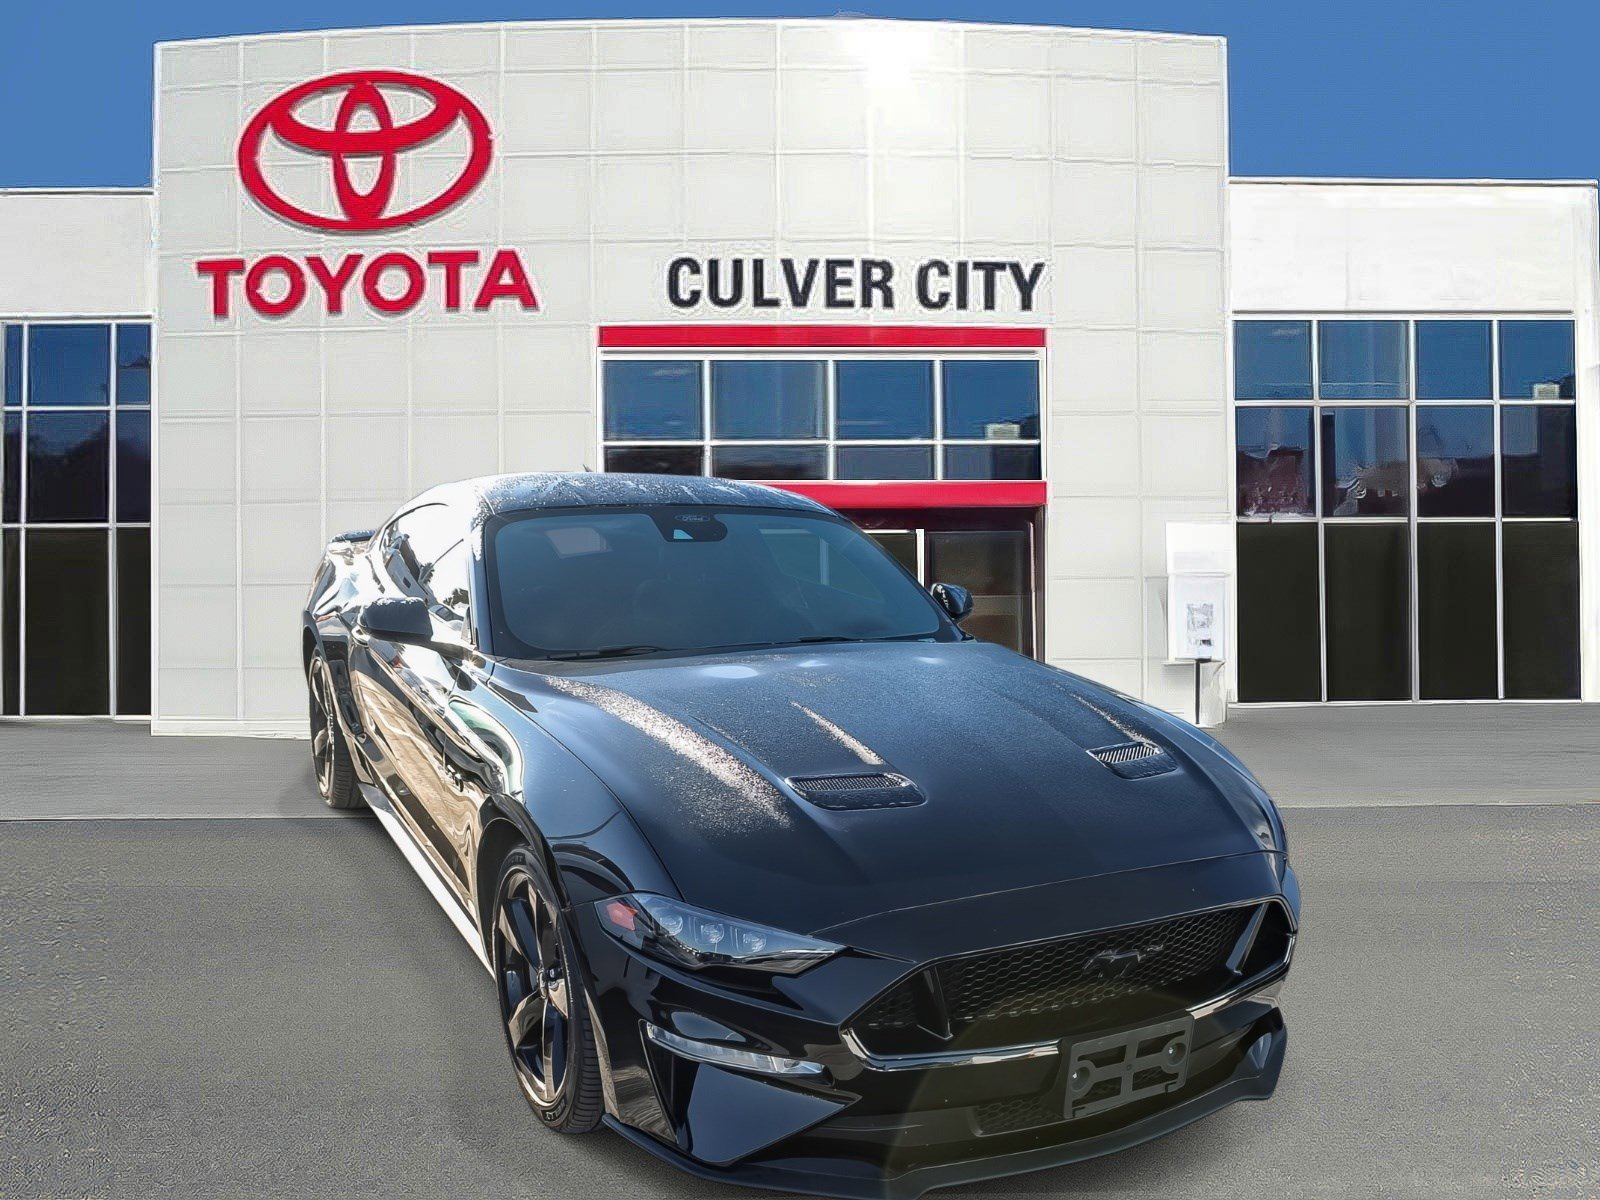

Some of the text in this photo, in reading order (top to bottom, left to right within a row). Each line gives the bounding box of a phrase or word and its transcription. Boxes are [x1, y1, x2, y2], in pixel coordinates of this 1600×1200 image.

[196, 250, 538, 317] TOYOTA
[668, 257, 1044, 310] CULVER CITY
